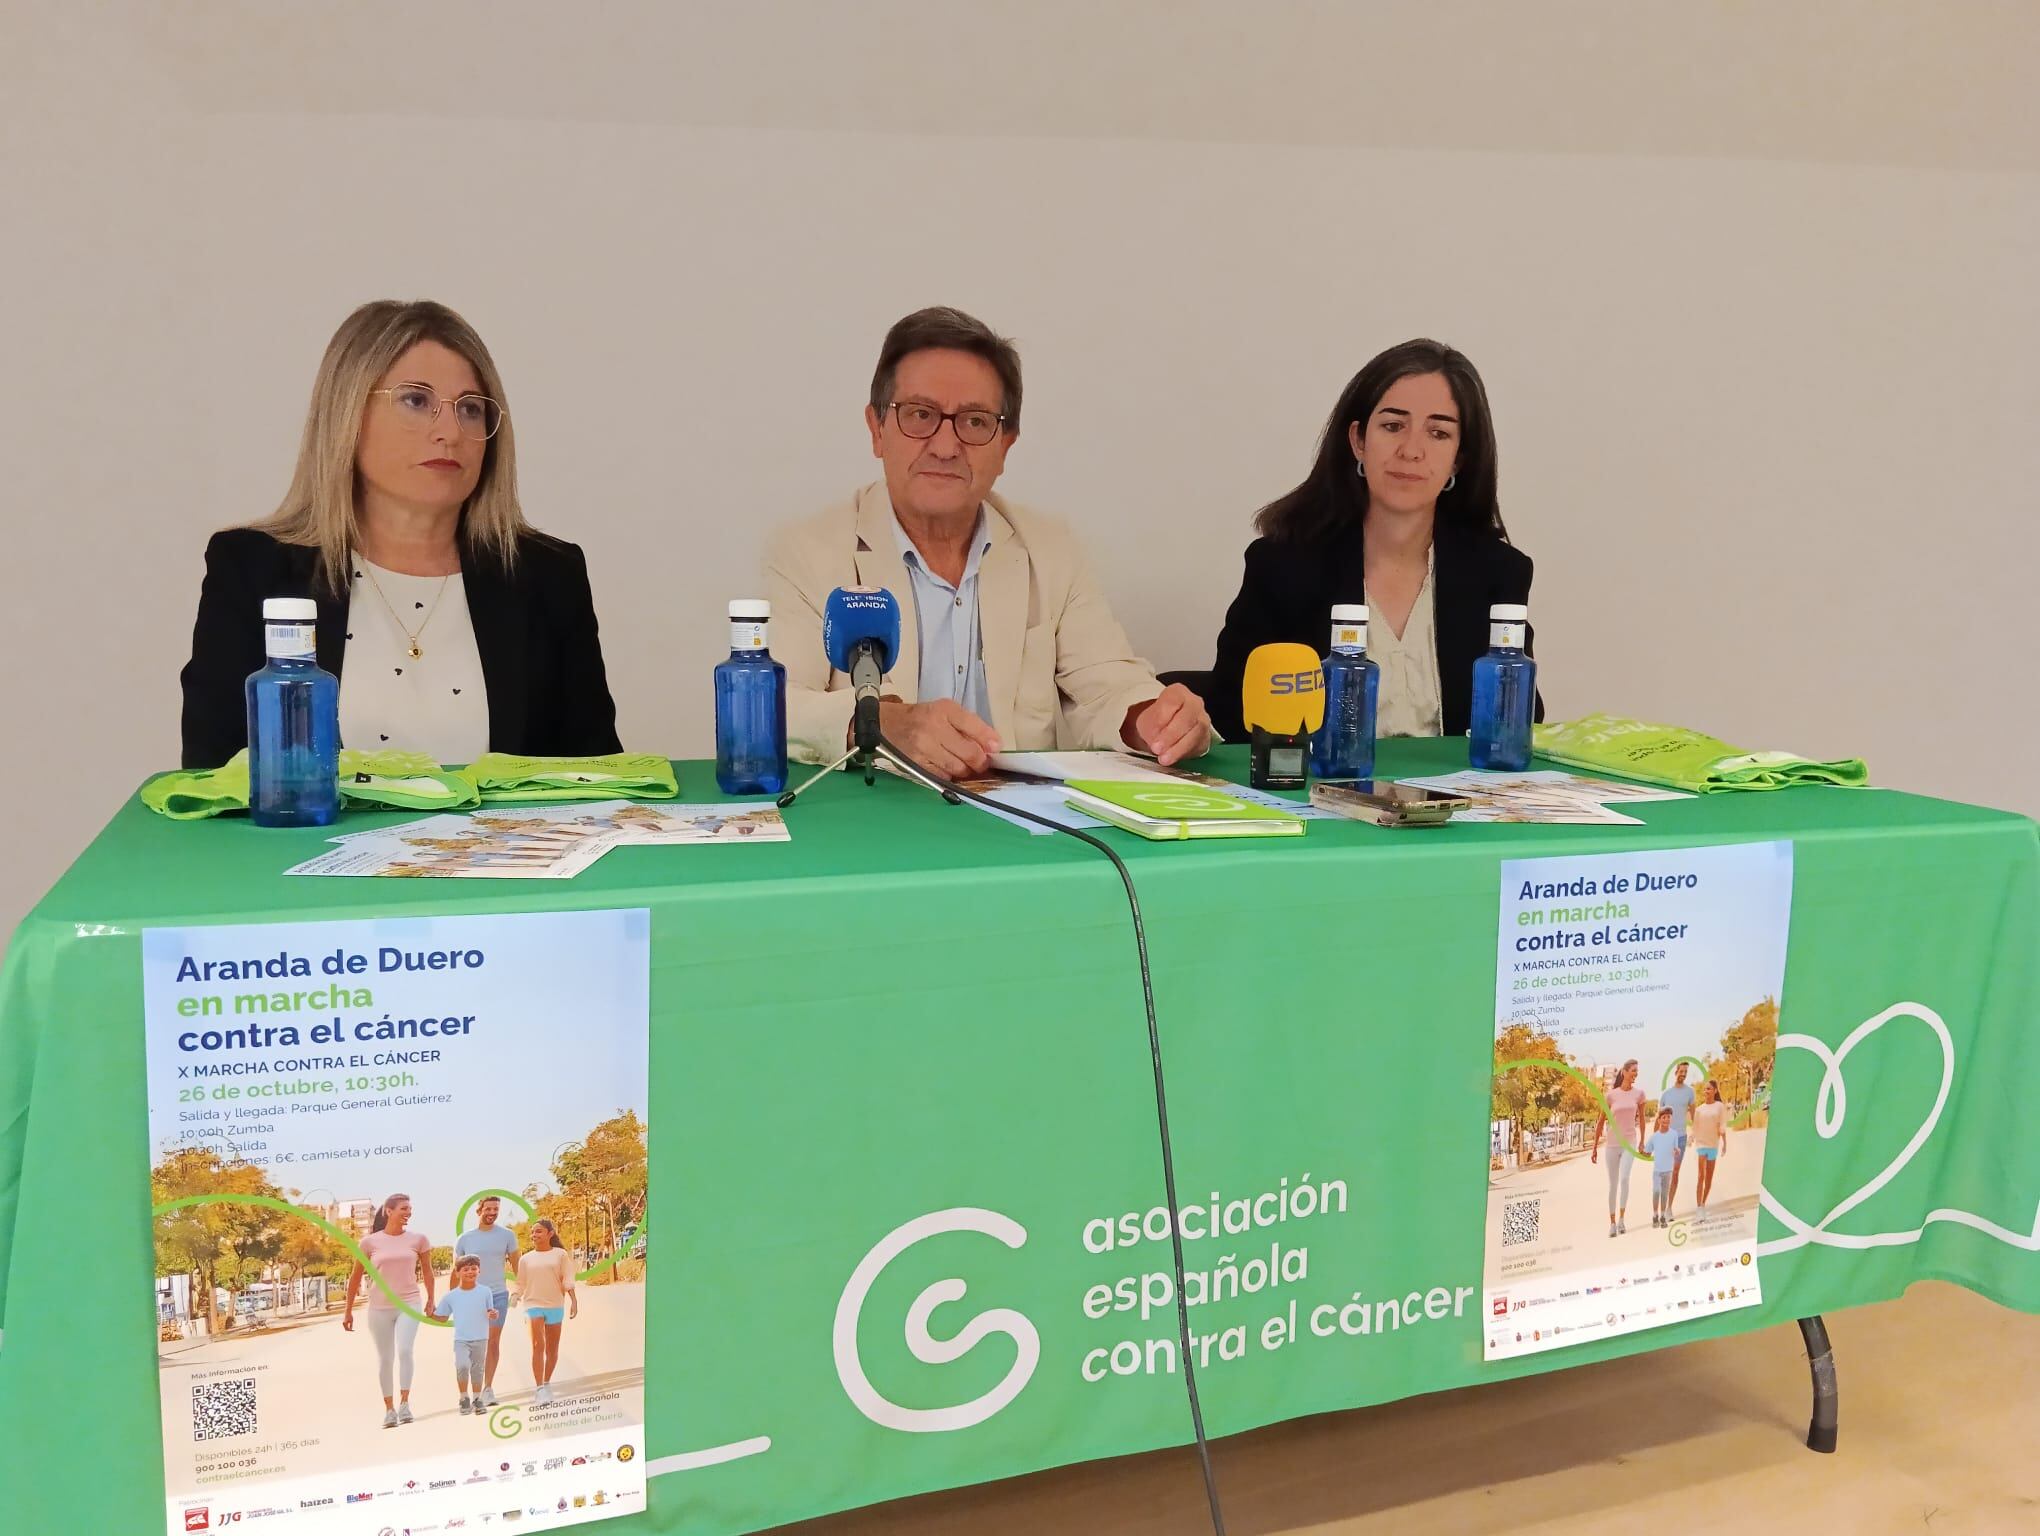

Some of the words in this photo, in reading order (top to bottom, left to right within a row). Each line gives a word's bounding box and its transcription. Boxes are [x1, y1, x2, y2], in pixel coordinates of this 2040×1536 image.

[846, 601, 887, 609] ARANDA
[1519, 877, 1597, 900] Aranda
[1603, 875, 1629, 895] de
[1635, 872, 1698, 892] Duero
[1517, 908, 1543, 926] en
[1550, 900, 1631, 923] marcha
[1516, 929, 1586, 952] contra
[1591, 925, 1611, 946] el
[1617, 922, 1689, 944] cáncer
[176, 951, 312, 982] Aranda
[321, 948, 368, 976] de
[379, 944, 485, 973] Duero
[1514, 963, 1520, 972] X
[1522, 958, 1566, 971] MARCHA
[1568, 954, 1609, 968] CONTRA
[1612, 953, 1623, 964] EL
[1513, 976, 1528, 990] 26
[1531, 974, 1548, 988] de
[177, 991, 224, 1017] en
[235, 982, 374, 1015] marcha
[1512, 994, 1535, 1005] Salida
[1536, 996, 1541, 1005] y
[1575, 988, 1603, 1000] Parque
[1604, 985, 1635, 996] General
[1537, 1004, 1565, 1015] Zumba
[178, 1020, 300, 1052] contra
[310, 1016, 345, 1044] el
[354, 1012, 476, 1041] cáncer
[1536, 1018, 1560, 1028] Salida
[178, 1066, 189, 1078] X
[194, 1060, 270, 1077] MARCHA
[274, 1056, 345, 1072] CONTRA
[350, 1055, 370, 1067] EL
[373, 1049, 441, 1066] CÁNCER
[179, 1084, 206, 1102] 26
[212, 1081, 241, 1101] de
[246, 1076, 340, 1099] octubre,
[345, 1071, 420, 1093] 10:30h.
[179, 1106, 220, 1122] Salida
[223, 1109, 232, 1122] y
[235, 1103, 289, 1121] llegada:
[291, 1101, 338, 1117] Parque
[341, 1096, 391, 1111] General
[394, 1092, 453, 1107] Gutiérrez
[180, 1126, 224, 1139] 10:00h
[228, 1124, 275, 1137] Zumba
[180, 1143, 223, 1156] 10:30h
[226, 1140, 267, 1152] Salida
[301, 1147, 360, 1162] camiseta
[362, 1147, 371, 1159] y
[374, 1142, 413, 1156] dorsal
[1083, 1172, 1349, 1254] asociación
[1083, 1241, 1309, 1321] española
[1081, 1324, 1246, 1383] contra
[1261, 1300, 1298, 1352] el
[1309, 1282, 1474, 1338] cáncer
[208, 1365, 256, 1378] información
[529, 1398, 577, 1413] asociación
[579, 1391, 620, 1405] española
[528, 1411, 559, 1422] contra
[561, 1409, 569, 1417] el
[570, 1405, 601, 1416] cáncer
[543, 1419, 579, 1431] Aranda
[595, 1411, 623, 1422] Duero
[195, 1447, 253, 1463] Disponibles
[255, 1443, 273, 1455] 24h
[280, 1440, 298, 1452] 365
[195, 1464, 215, 1475] 900
[217, 1461, 236, 1470] 100
[238, 1456, 257, 1468] 036
[300, 1497, 334, 1508] haizea
[218, 1511, 242, 1527] JJG
